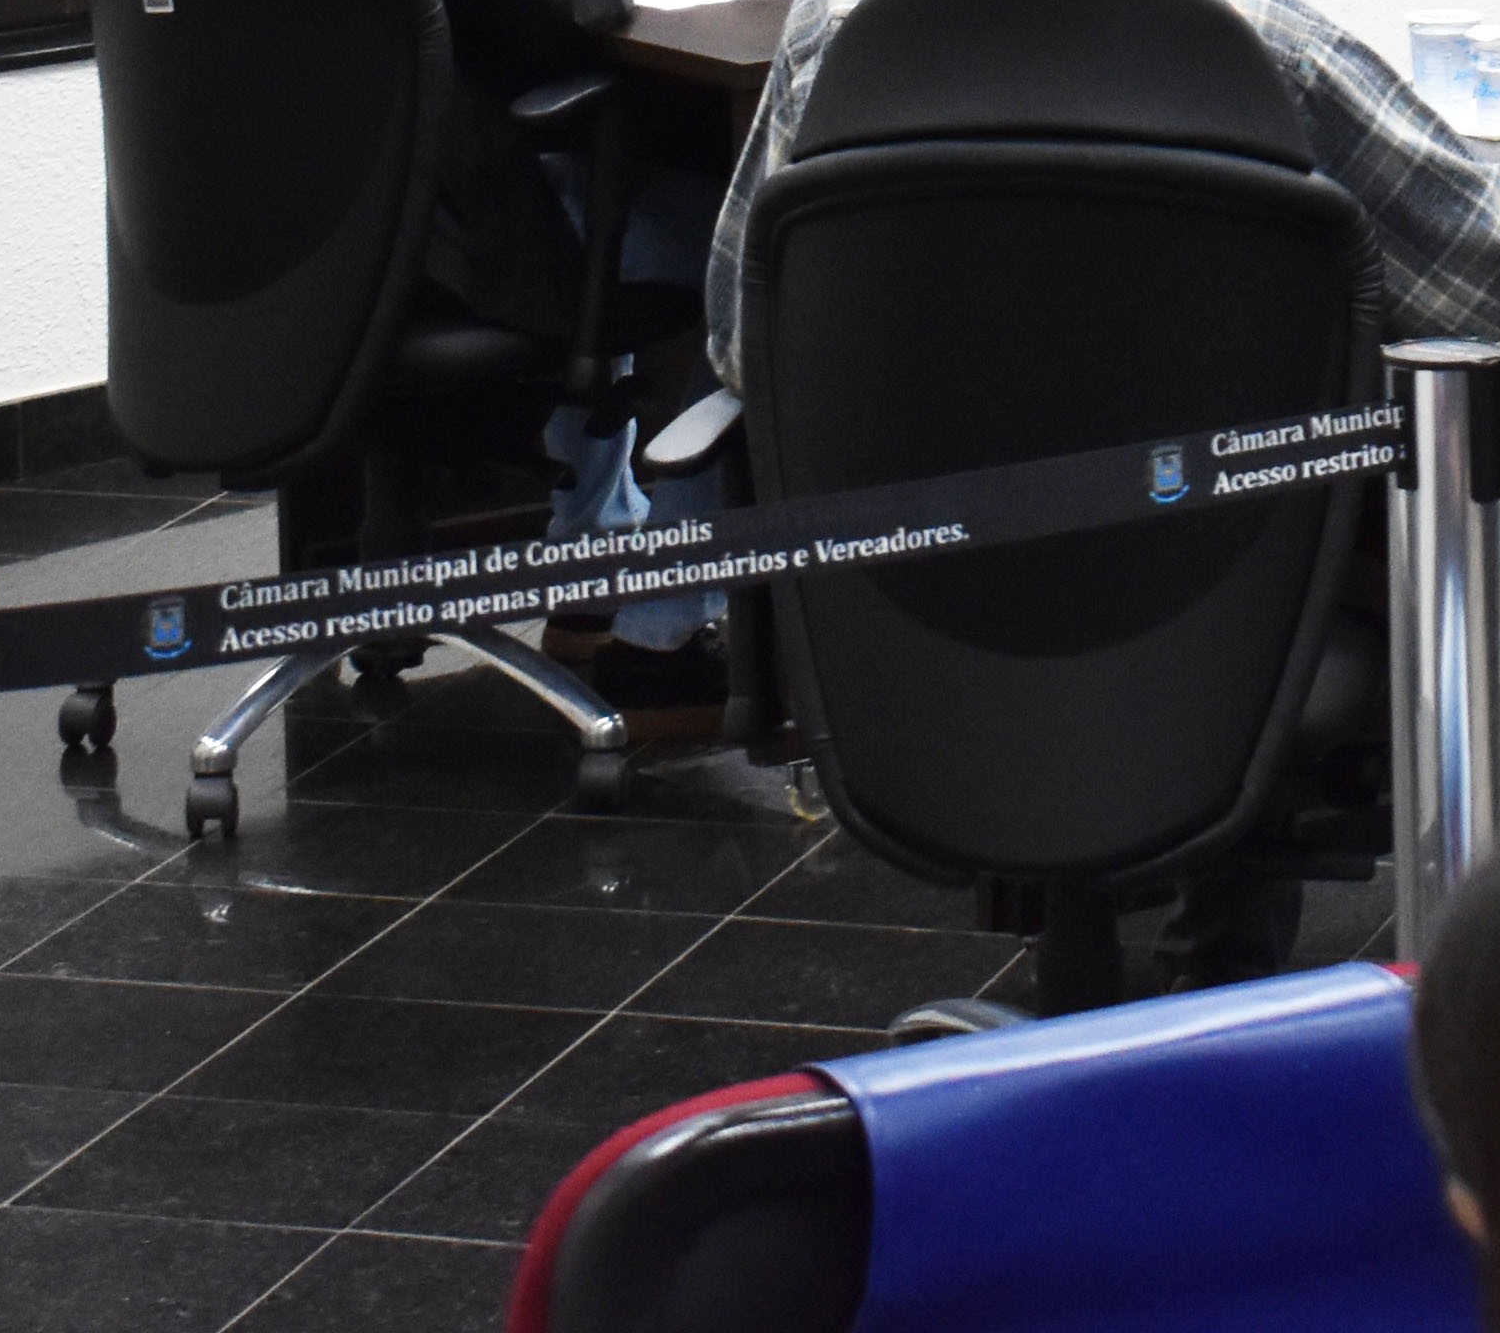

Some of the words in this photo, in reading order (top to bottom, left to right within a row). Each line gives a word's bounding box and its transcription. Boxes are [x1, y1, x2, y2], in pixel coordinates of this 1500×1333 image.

[1310, 402, 1404, 440] Municip
[1212, 464, 1297, 496] Acesso
[1301, 444, 1394, 479] restrito
[220, 577, 330, 610] Câmara
[338, 549, 478, 594] Municipal
[484, 546, 519, 574] de
[524, 518, 713, 567] Cordeirópolis
[220, 621, 319, 653] Acesso
[326, 602, 434, 637] restrito
[440, 588, 541, 624] apenas
[546, 578, 610, 611] para
[616, 550, 788, 594] funcionários
[792, 549, 809, 568] e
[814, 523, 970, 563] Vereadores.
